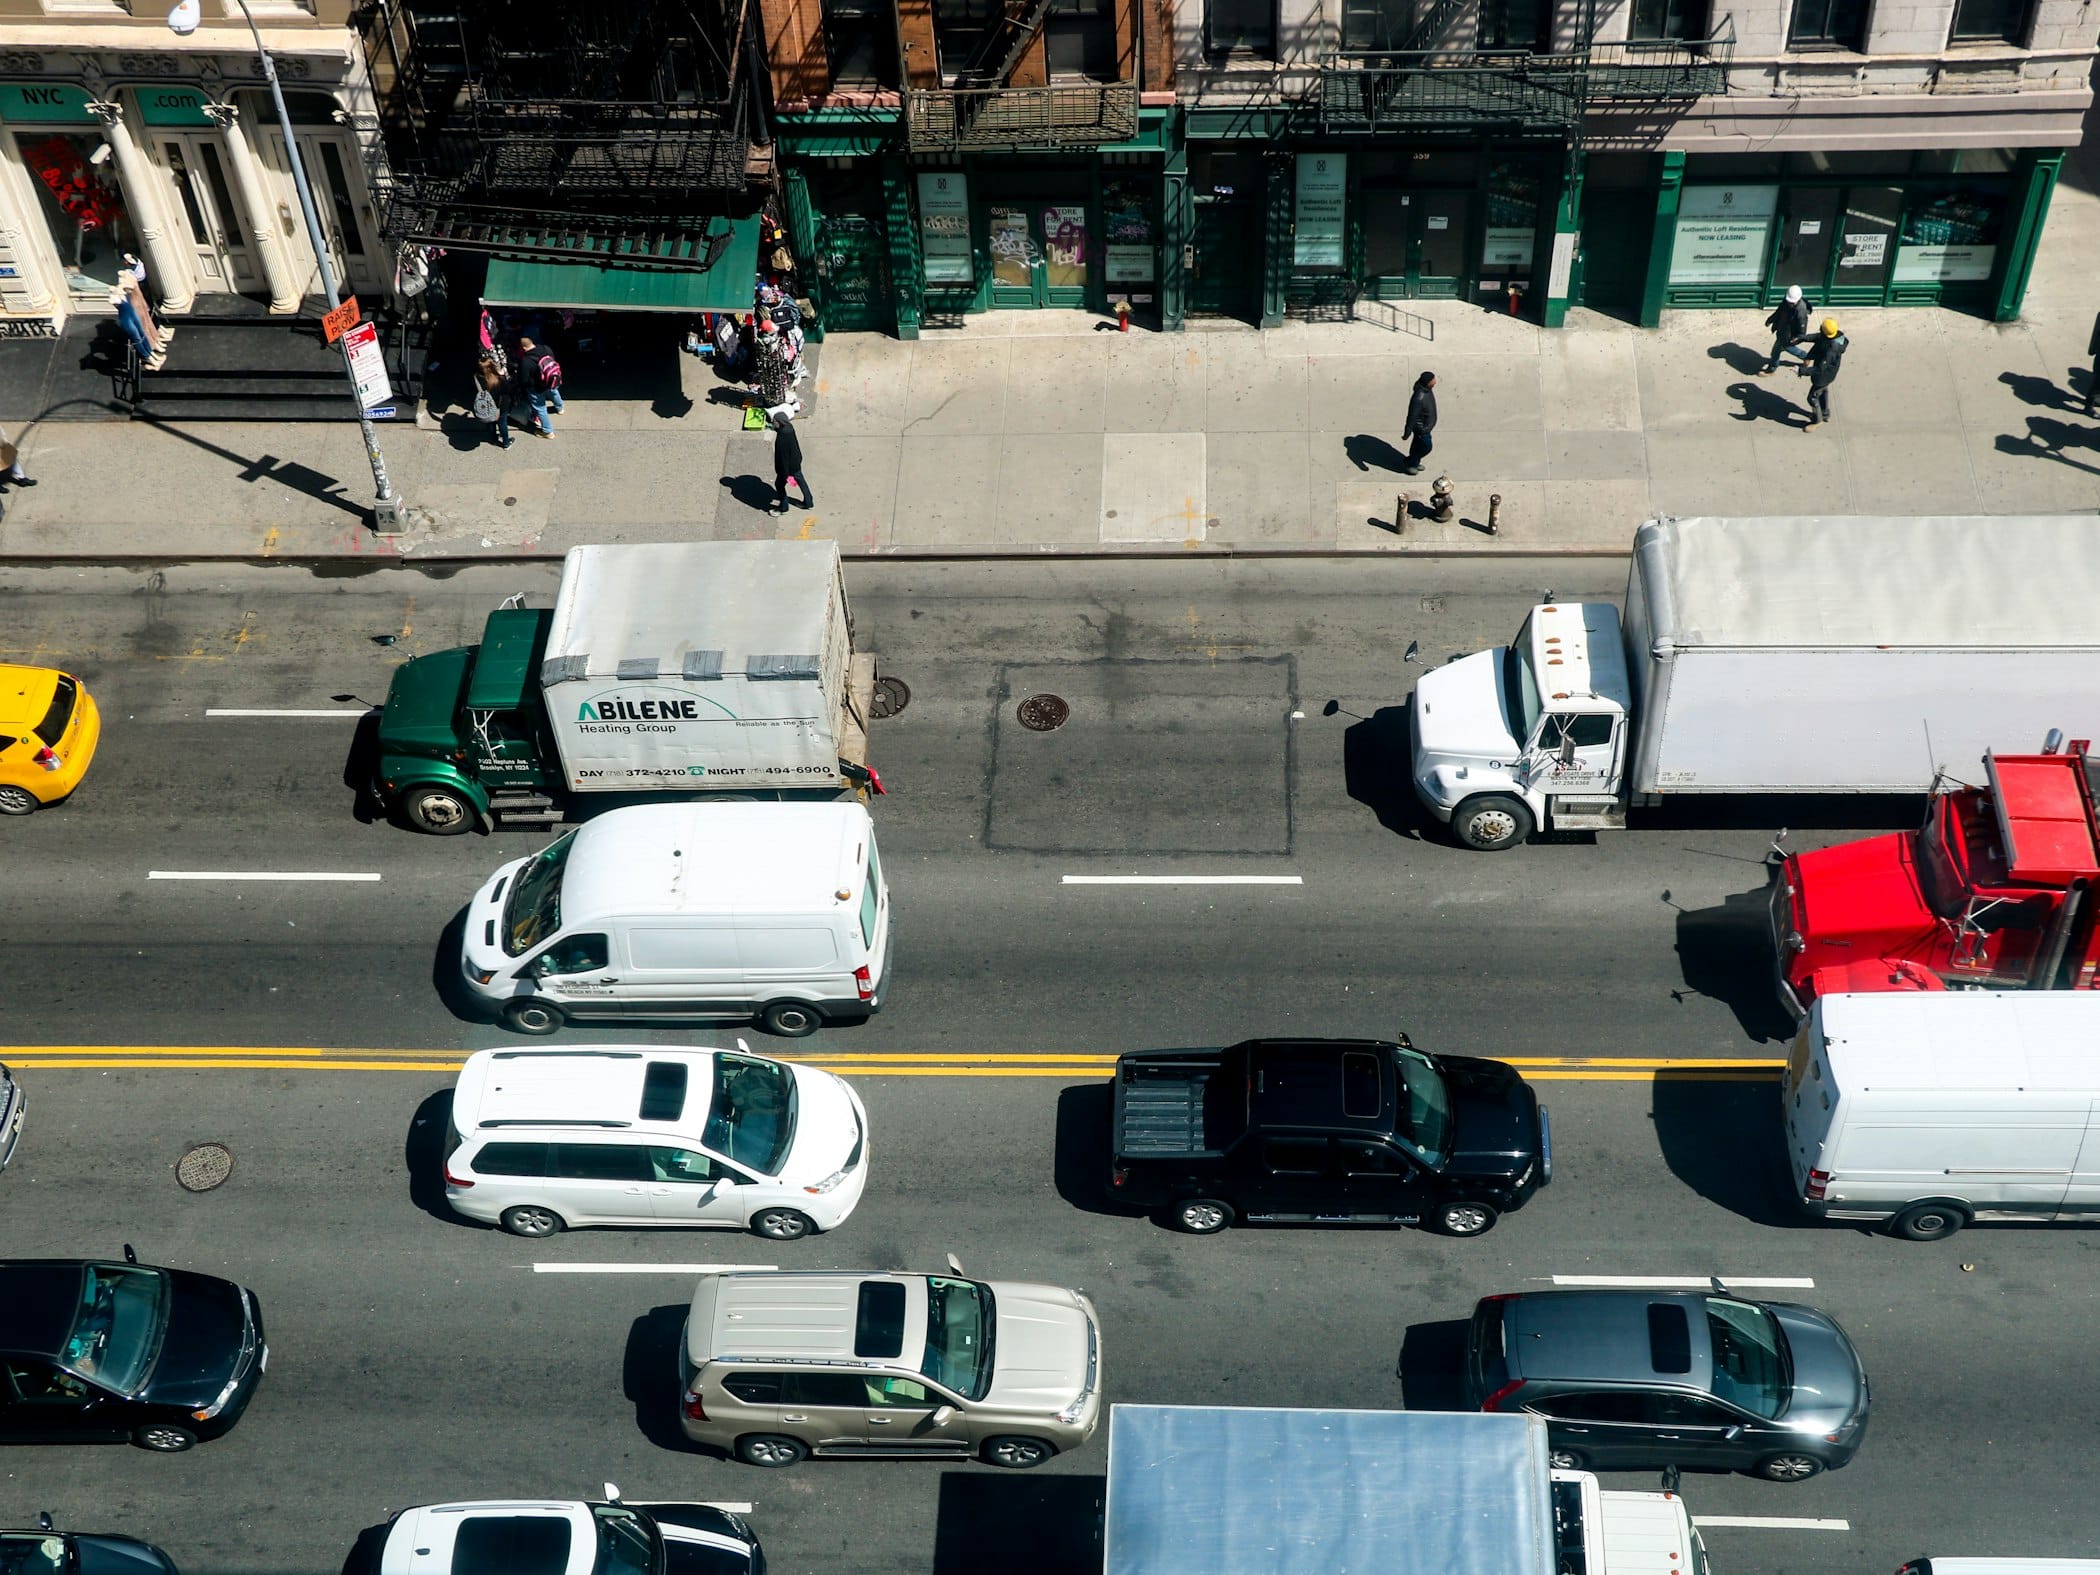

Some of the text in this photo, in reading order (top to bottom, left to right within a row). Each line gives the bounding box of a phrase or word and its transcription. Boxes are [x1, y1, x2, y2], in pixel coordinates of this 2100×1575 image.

[22, 88, 65, 105] NYC
[154, 94, 198, 108] .com
[1861, 243, 1883, 251] RENT
[327, 302, 355, 326] RAISE
[331, 314, 356, 337] PLOW
[578, 697, 699, 720] ABILENE
[579, 723, 677, 734] Heating Group
[765, 766, 831, 774] 494-6900
